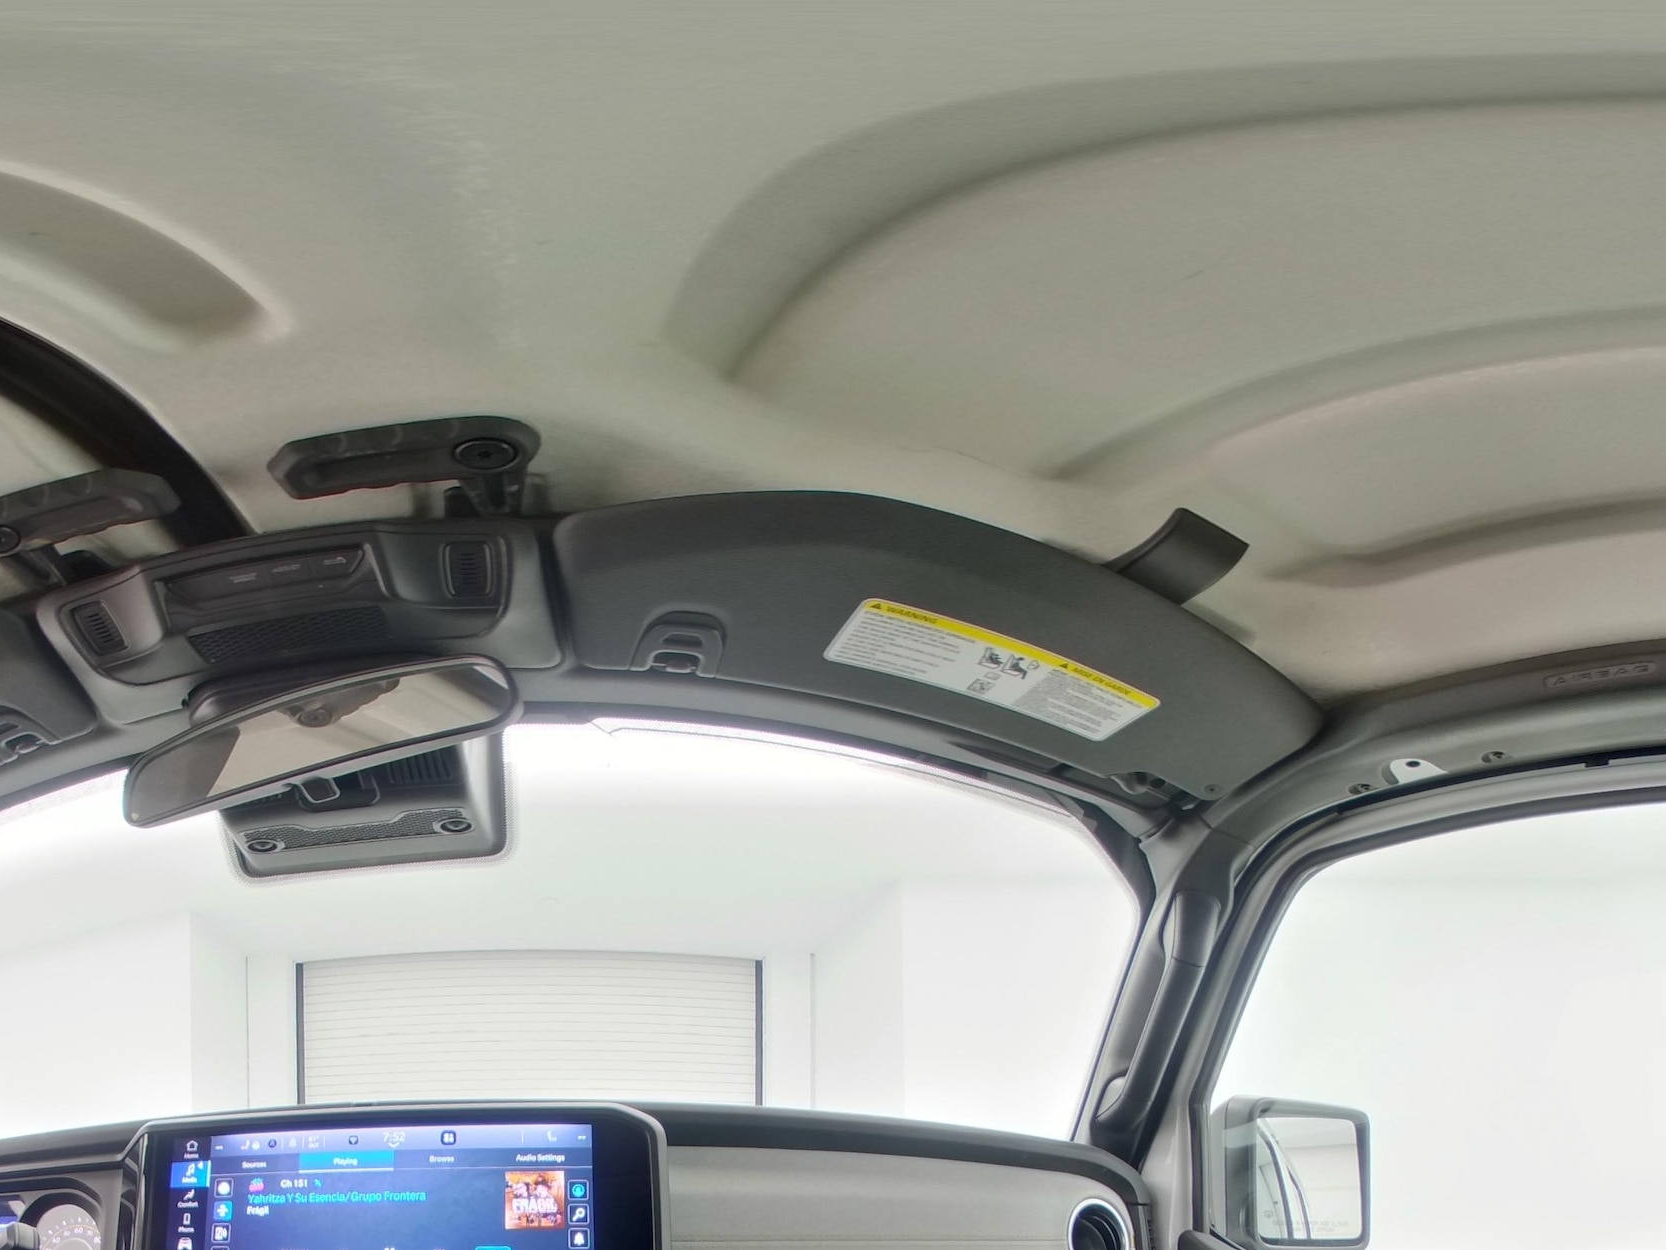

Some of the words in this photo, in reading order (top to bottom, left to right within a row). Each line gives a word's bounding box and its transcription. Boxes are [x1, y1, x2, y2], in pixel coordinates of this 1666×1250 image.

[886, 605, 937, 624] WARNING
[382, 1132, 406, 1143] 7:52
[332, 1156, 358, 1167] Playing
[429, 1154, 455, 1163] Browse
[515, 1153, 537, 1163] Audio
[537, 1153, 566, 1164] Settings
[241, 1160, 267, 1169] Sources
[280, 1178, 293, 1189] Ch
[294, 1178, 309, 1189] 151
[247, 1192, 286, 1205] Yahritza
[286, 1192, 295, 1204] Y
[295, 1192, 308, 1204] Su
[308, 1190, 382, 1204] Esencia/Grupo
[383, 1190, 427, 1202] Frontera
